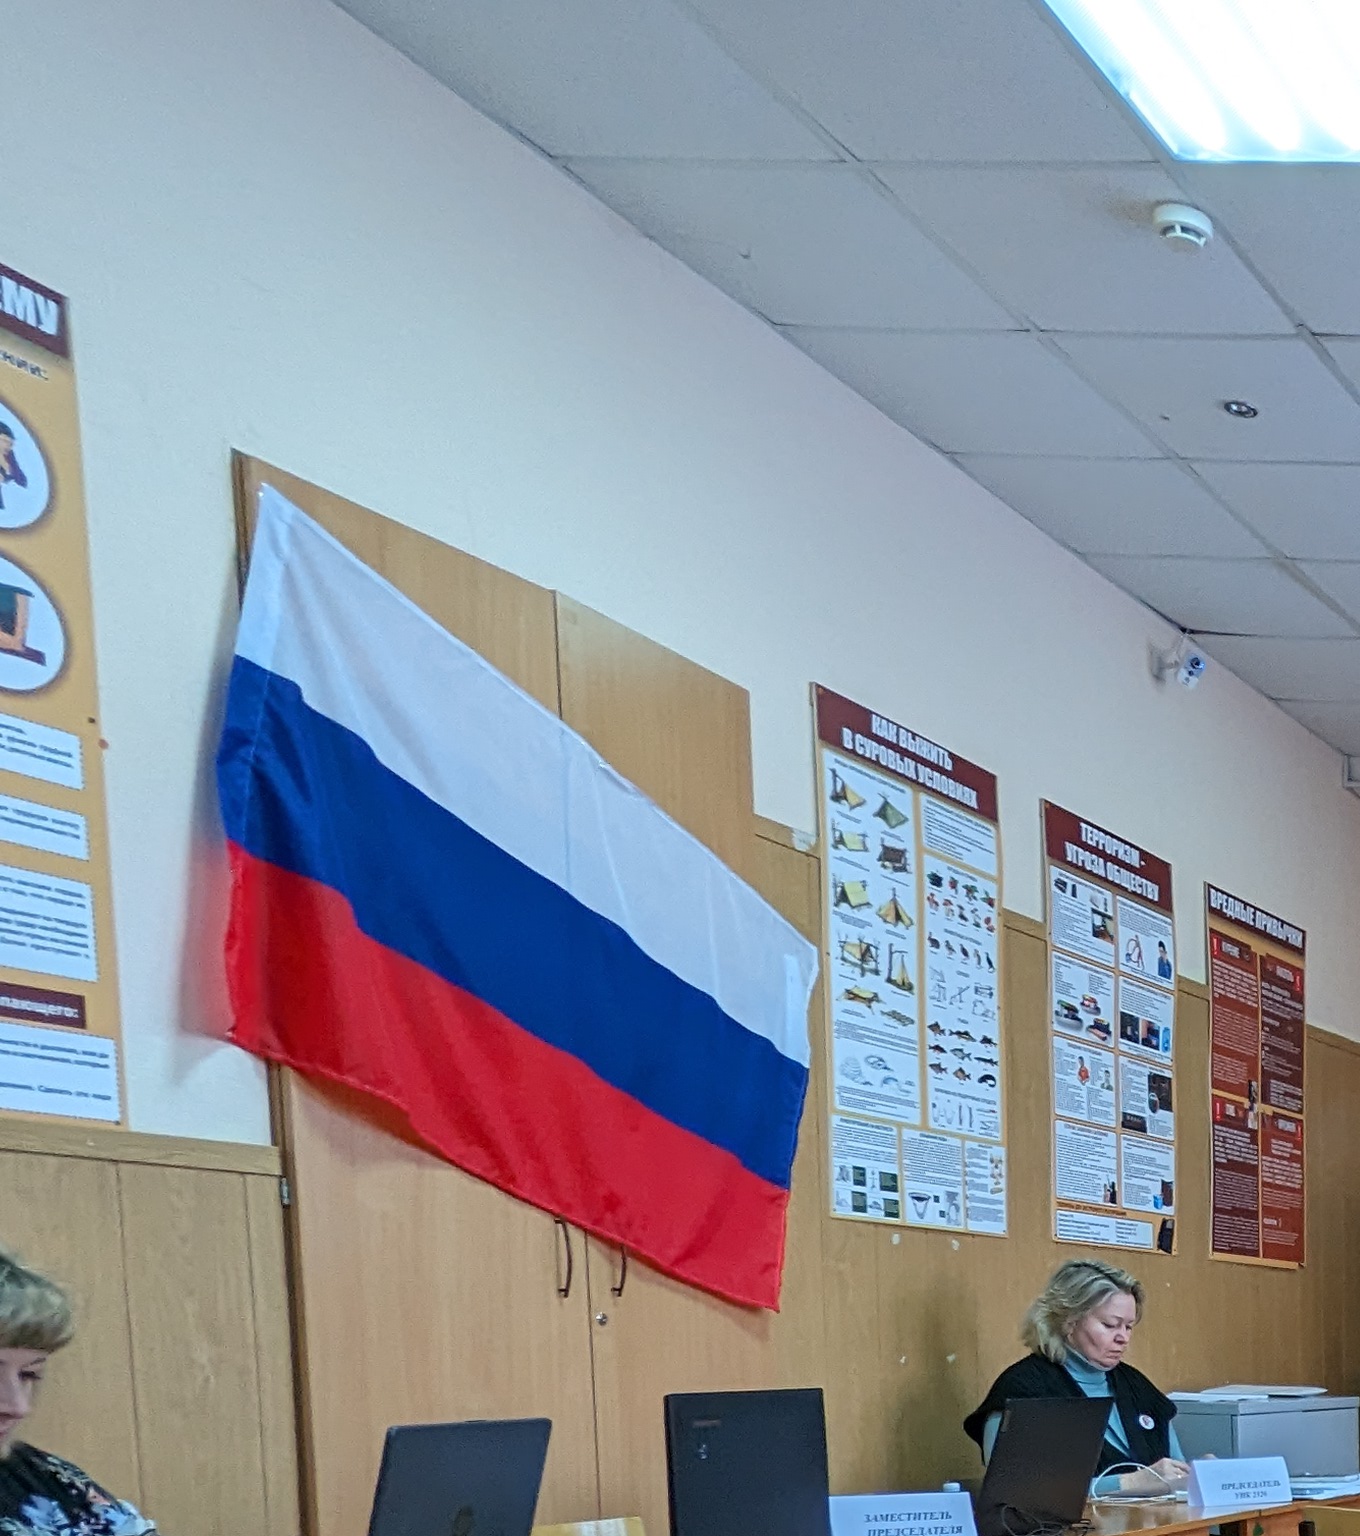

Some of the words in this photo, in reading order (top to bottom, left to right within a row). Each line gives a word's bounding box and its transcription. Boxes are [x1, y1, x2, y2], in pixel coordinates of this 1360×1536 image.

[0, 275, 58, 335] МУ
[842, 727, 853, 750] В
[854, 733, 917, 780] СУРОВЫХ
[917, 763, 979, 810] УСЛОВИЯХ
[871, 713, 898, 744] КАК
[899, 727, 953, 771] ВЫЖИТЬ
[1064, 841, 1106, 878] УГРОЗА
[1106, 861, 1159, 902] ОБЩЕСТВУ
[1079, 821, 1140, 868] ТЕРРОРИЗМ
[1209, 887, 1255, 925] ВРЕДНЫЕ
[1255, 910, 1303, 949] ПРИВЫЧКИ
[864, 1511, 952, 1523] ЗАМЕСТИТЕЛЬ
